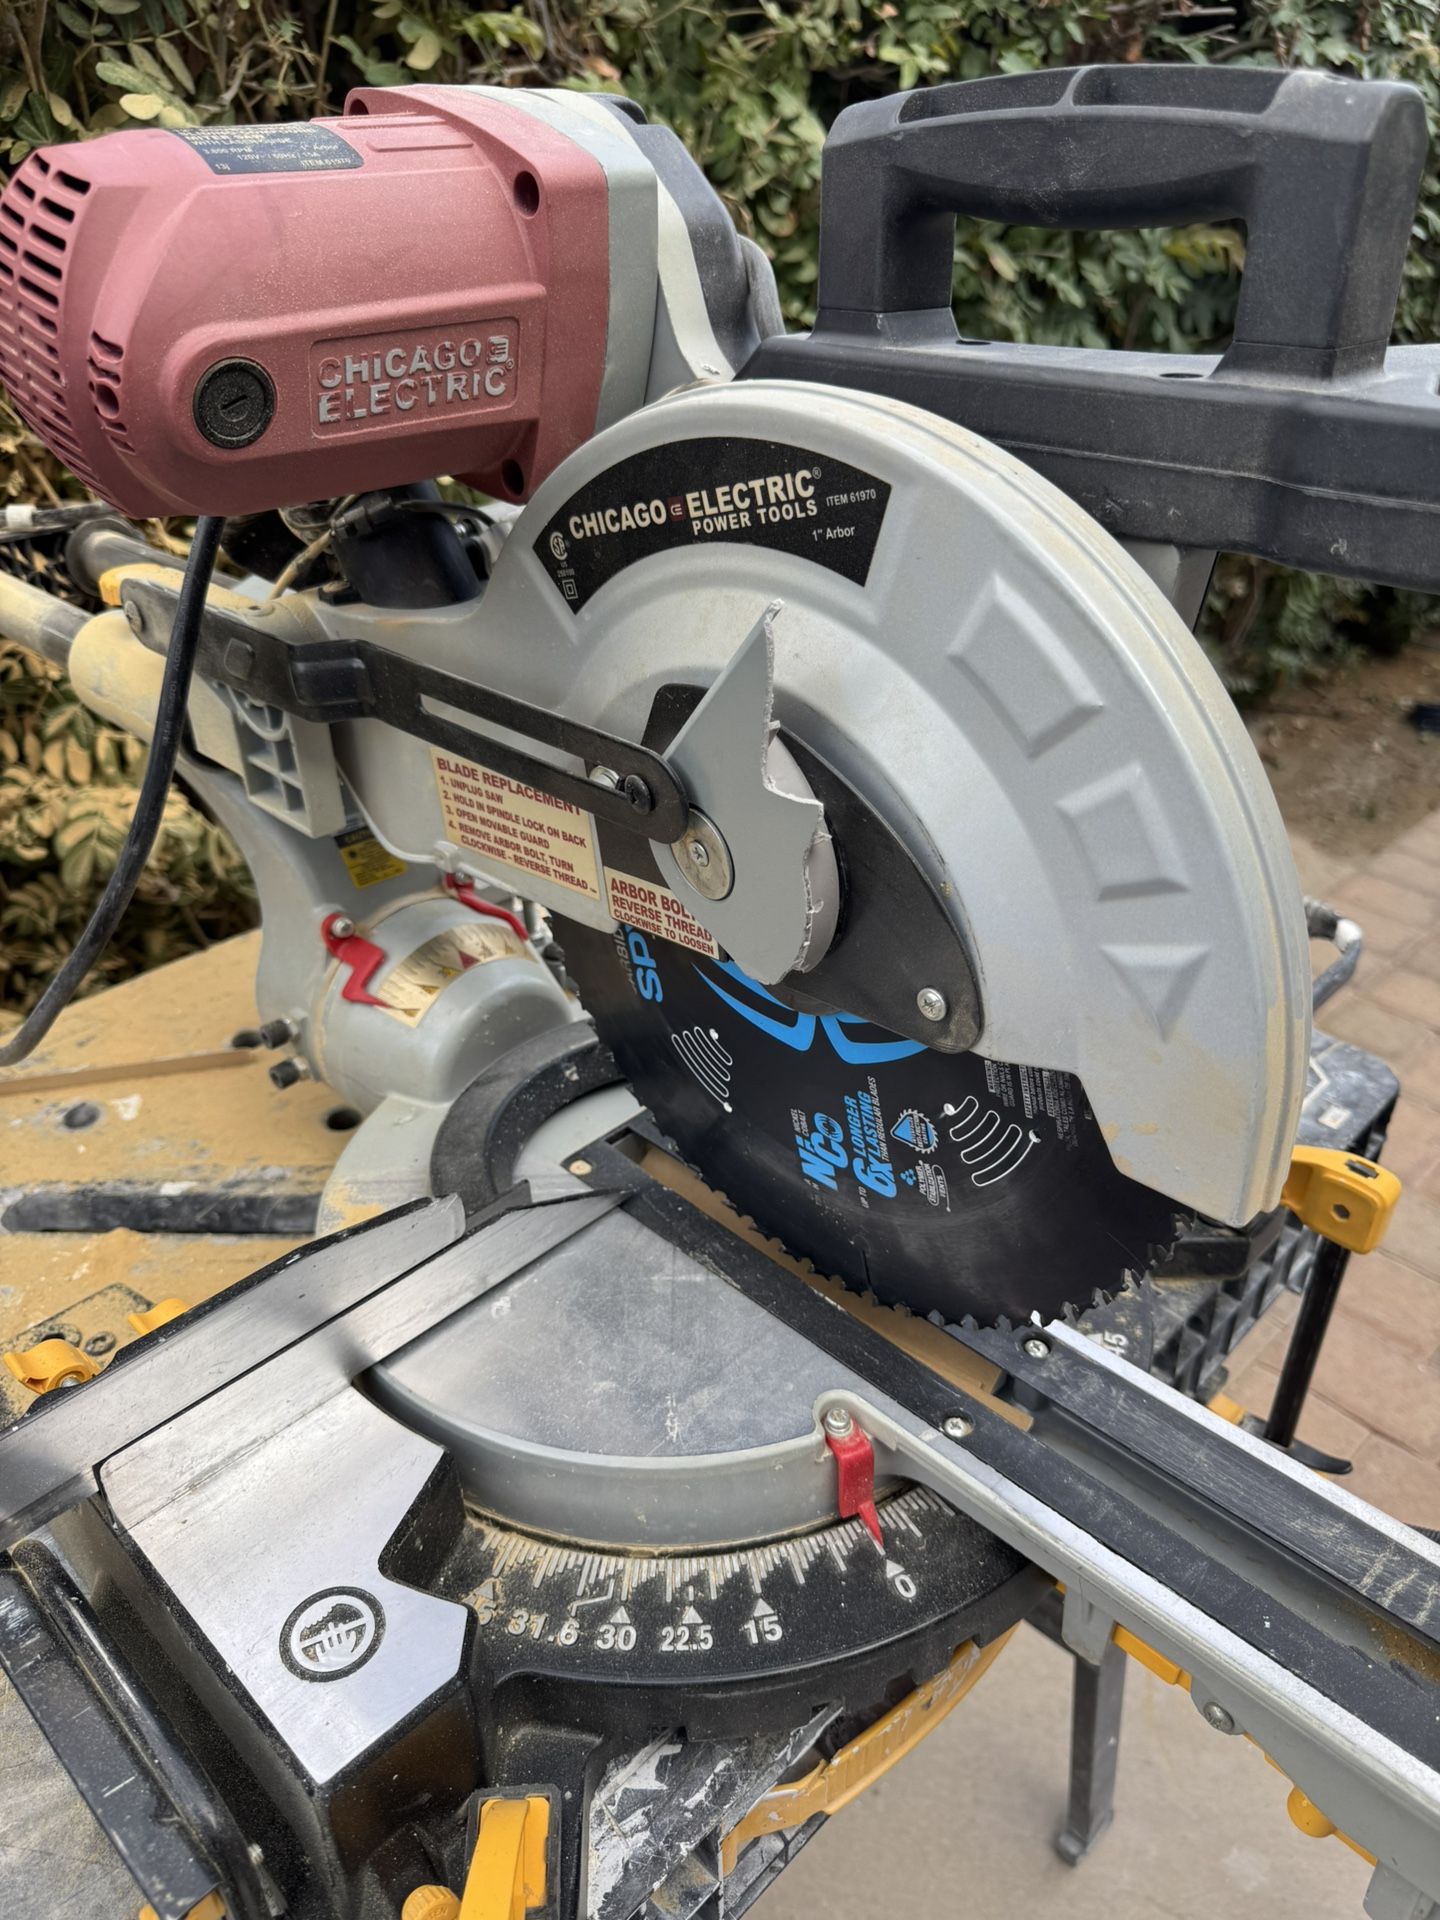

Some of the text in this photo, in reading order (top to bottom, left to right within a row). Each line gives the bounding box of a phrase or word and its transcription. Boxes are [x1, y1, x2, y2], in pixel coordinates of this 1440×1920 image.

[318, 338, 481, 389] CHICAGO
[318, 366, 507, 425] ELECTRIC
[568, 498, 668, 541] CHICAGO
[692, 499, 818, 536] POWER TOOLS
[826, 488, 878, 508] ITEM 61970
[825, 524, 856, 541] Arbor
[437, 757, 582, 817] BLADE REPLACEMENT
[440, 775, 504, 805] 1. UNPLUG SAW
[443, 790, 588, 849] 2. HOLD IN SPINDLE LOCK ON BACK
[445, 804, 551, 850] 3. OPEN MOVABLE GUARD
[448, 820, 575, 873] 4. REMOVE ARBOR BOLT, TURN
[460, 834, 507, 860] CLOCKWISE
[513, 854, 552, 877] REVERSE
[552, 868, 589, 891] THREAD
[611, 877, 696, 921] ARBOR BOL
[612, 894, 713, 942] REVERSE THREAD
[613, 908, 714, 956] CLOCKWISE TO LOOSEN
[844, 1095, 866, 1157] LONGER
[857, 1090, 880, 1156] LASTING
[867, 1076, 890, 1162] THAN REGULAR BLADES
[858, 1185, 868, 1197] TO
[893, 1573, 917, 1598] 0
[508, 1609, 581, 1646] 31.6
[596, 1623, 638, 1652] 30
[660, 1625, 714, 1653] 22.5
[743, 1617, 784, 1645] 15
